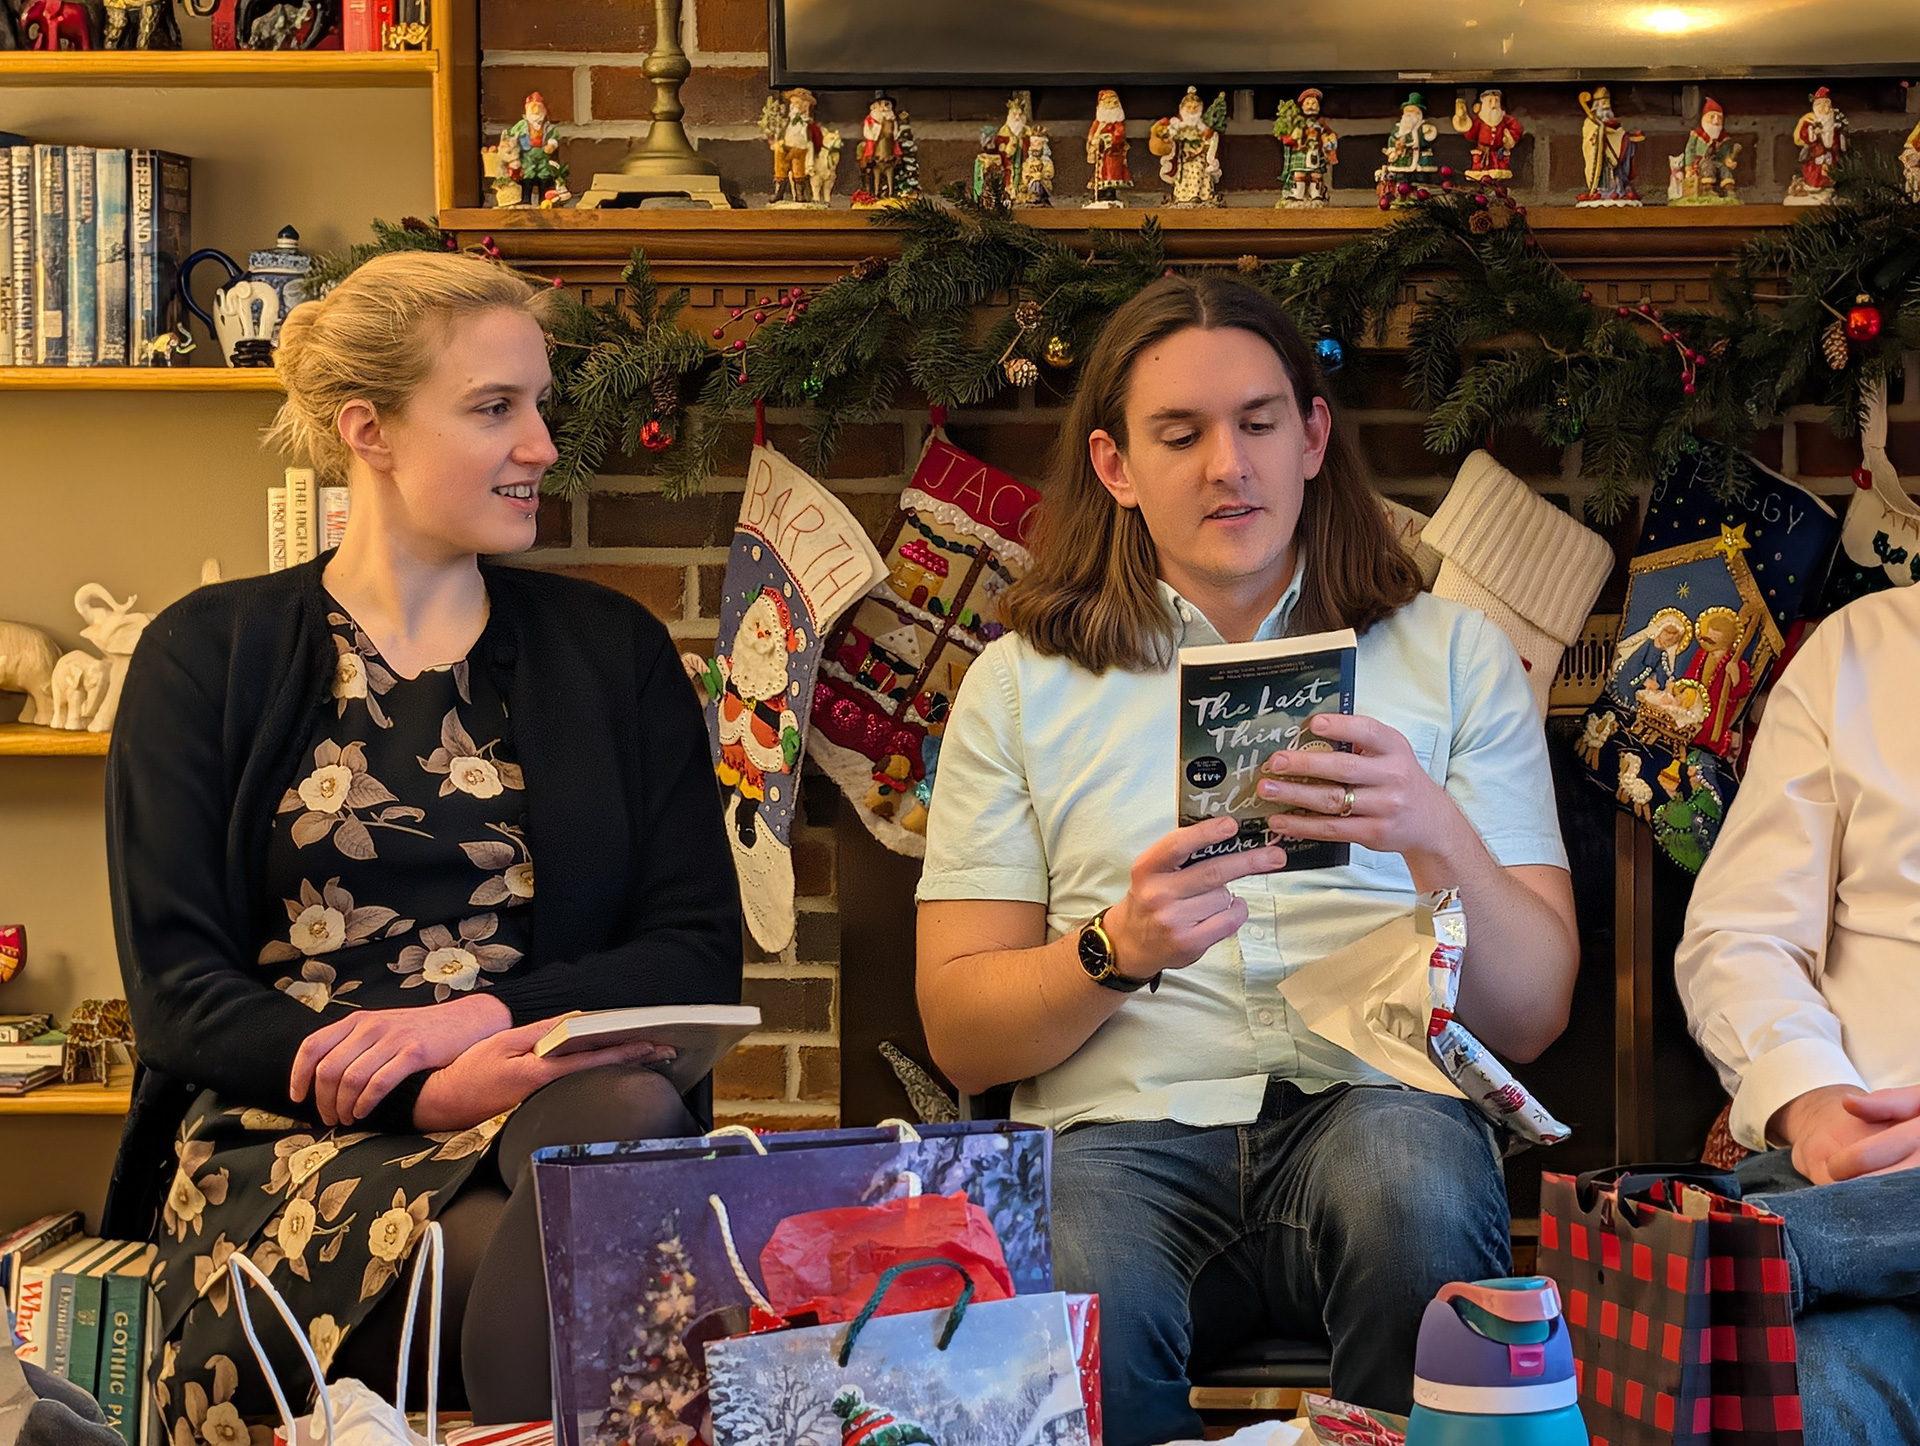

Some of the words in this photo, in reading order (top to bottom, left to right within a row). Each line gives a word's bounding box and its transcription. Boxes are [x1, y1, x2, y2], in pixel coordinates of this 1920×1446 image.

[295, 479, 306, 508] THE
[296, 510, 308, 547] HIGH
[748, 459, 863, 607] BARTH
[1189, 691, 1250, 726] The
[1258, 678, 1331, 715] Last
[1207, 720, 1310, 753] Thing
[1189, 785, 1266, 815] Told
[108, 1311, 129, 1396] GOTHIC
